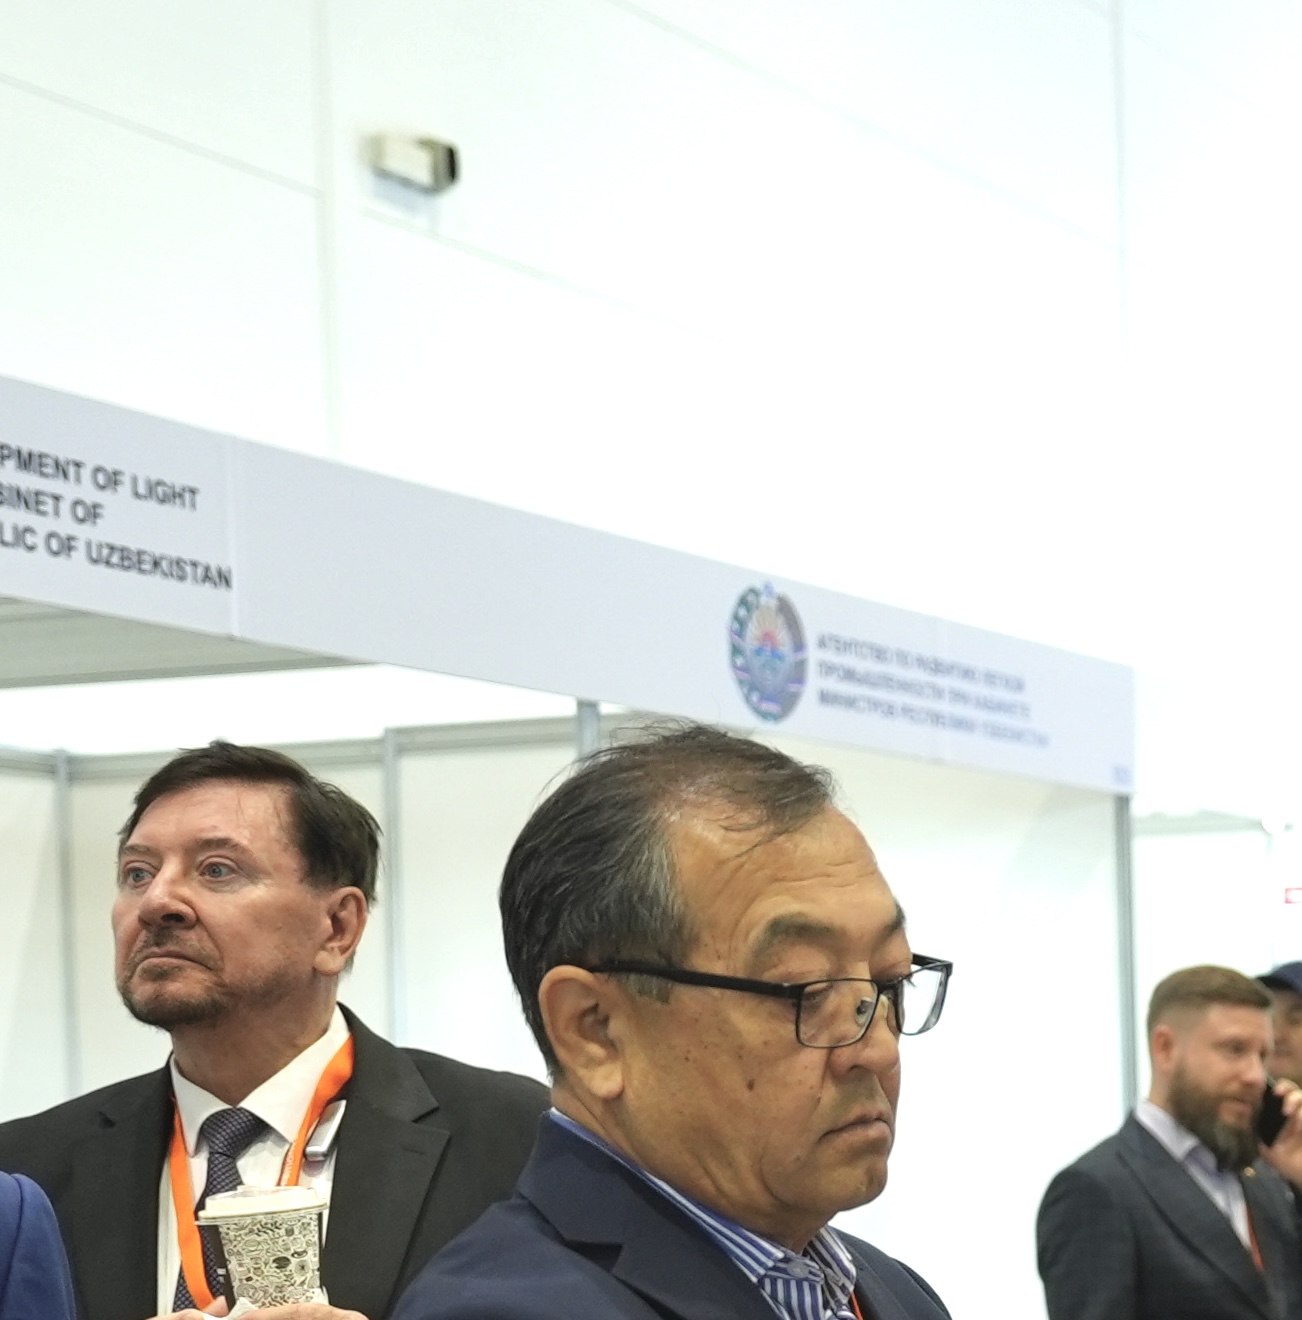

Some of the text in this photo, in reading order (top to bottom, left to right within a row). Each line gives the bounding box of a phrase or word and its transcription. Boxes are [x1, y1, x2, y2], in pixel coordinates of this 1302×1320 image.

[91, 464, 125, 493] OF
[131, 473, 200, 510] LIGHT
[70, 498, 104, 526] OF
[44, 529, 78, 558] OF
[86, 538, 233, 590] UZBEKISTAN
